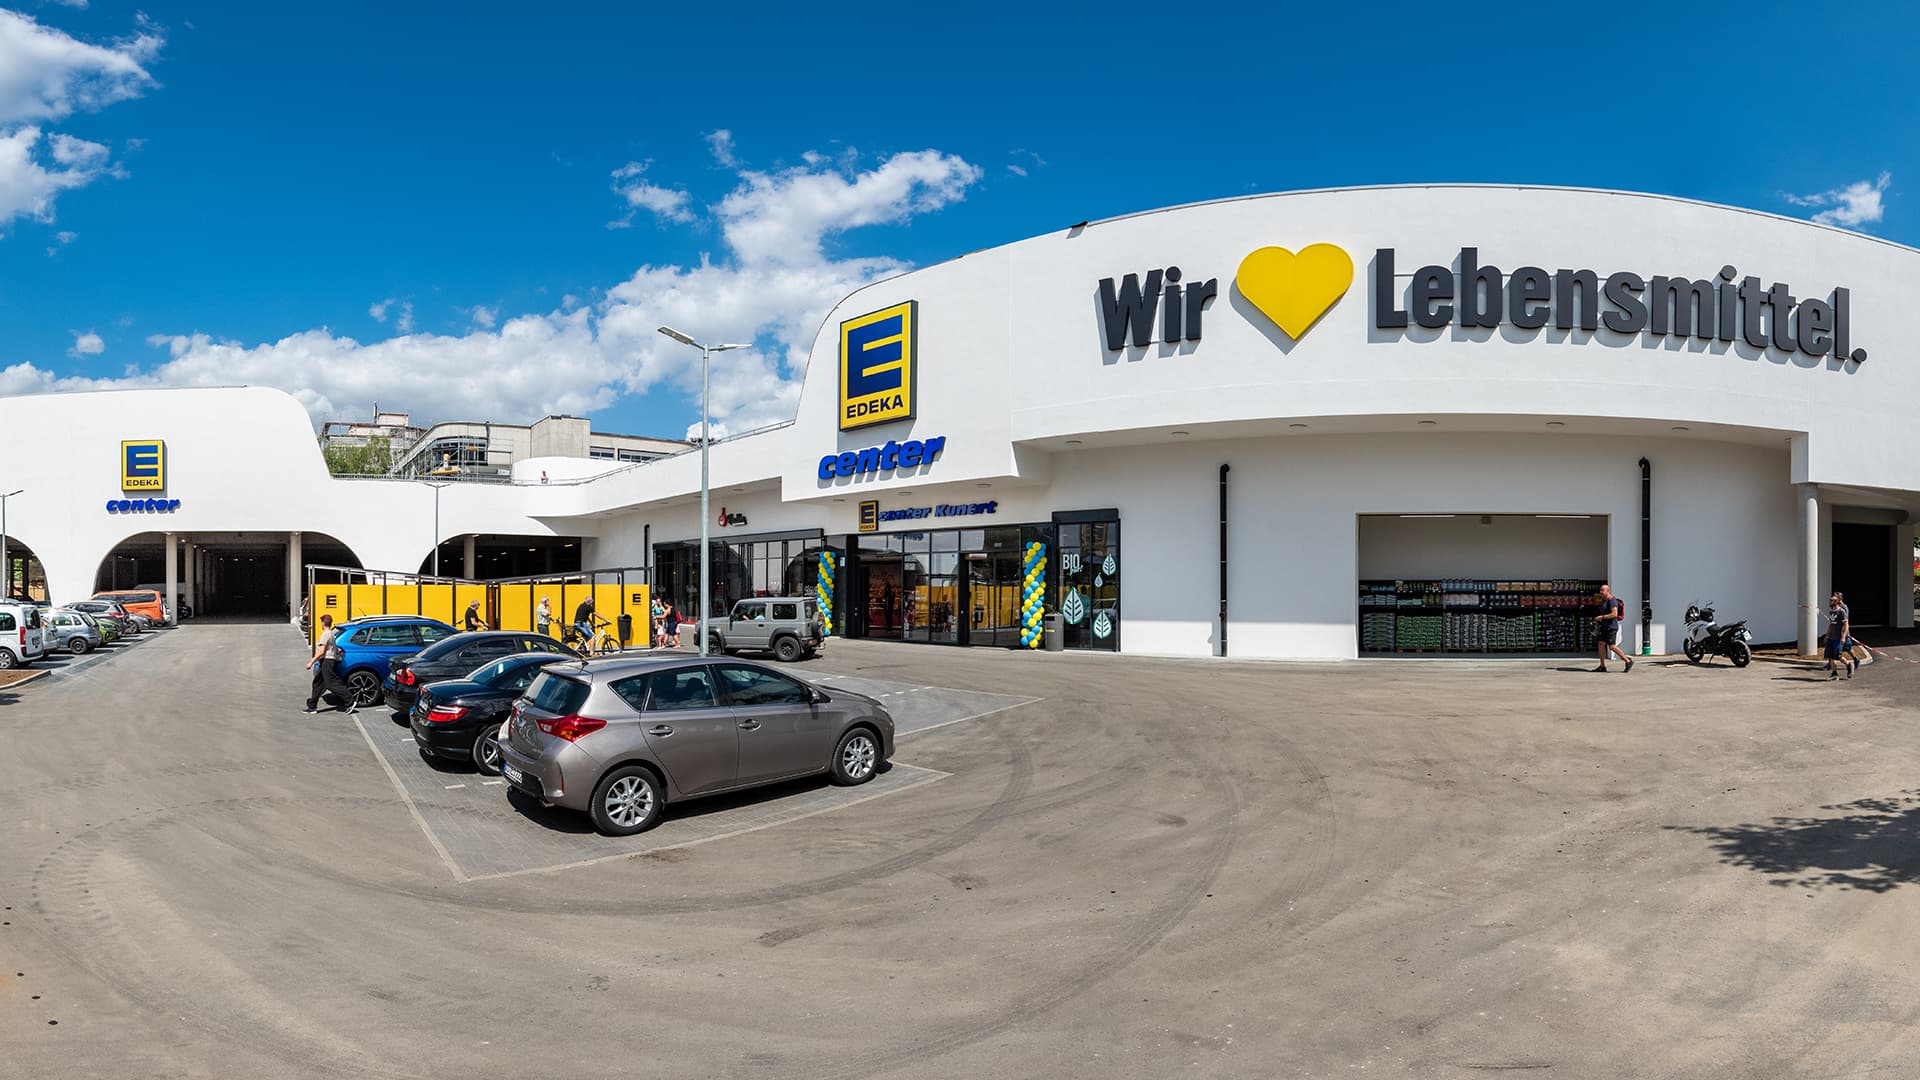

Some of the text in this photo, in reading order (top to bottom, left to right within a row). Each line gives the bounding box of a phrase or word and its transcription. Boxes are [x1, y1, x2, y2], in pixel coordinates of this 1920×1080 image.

[1098, 247, 1867, 363] Wir Lebensmittel.
[847, 314, 903, 399] E
[846, 394, 904, 419] EDEKA
[126, 445, 158, 477] E
[818, 435, 946, 480] center
[106, 498, 180, 511] center
[861, 505, 874, 523] E
[878, 501, 998, 521] center Kunert
[1063, 553, 1080, 570] BIO
